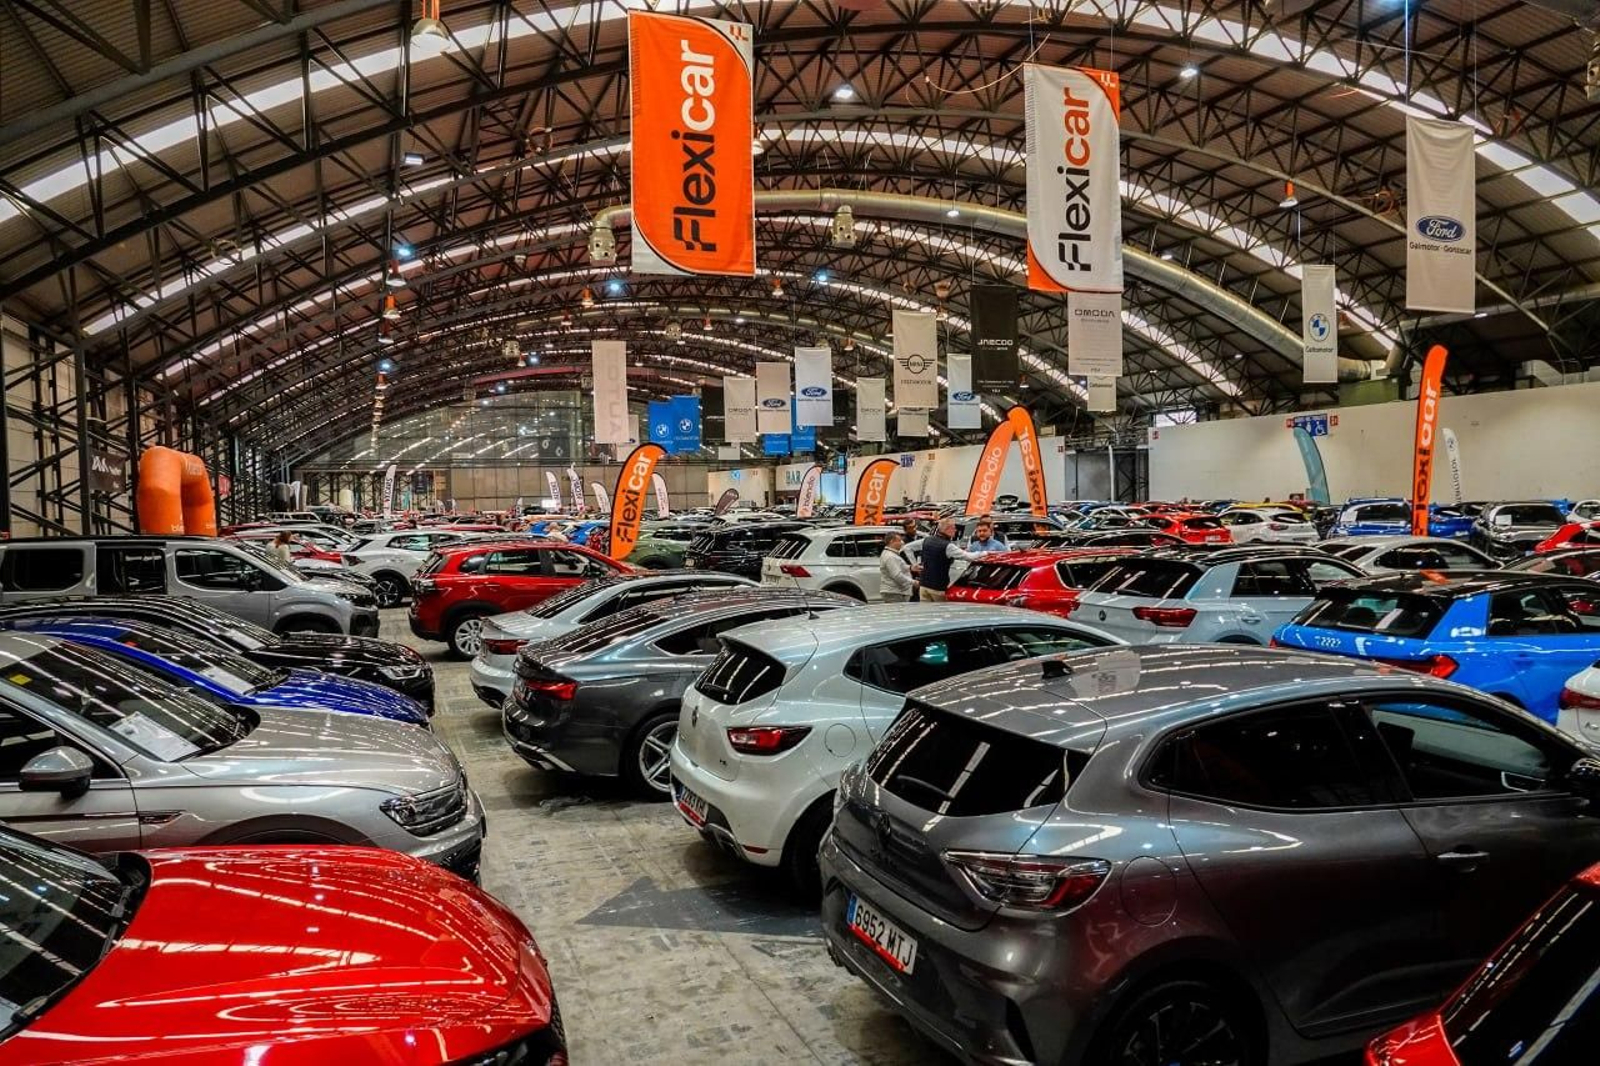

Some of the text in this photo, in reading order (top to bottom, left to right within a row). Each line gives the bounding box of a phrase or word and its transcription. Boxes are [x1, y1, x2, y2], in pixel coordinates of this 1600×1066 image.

[671, 39, 718, 252] Flexicar
[1057, 87, 1092, 272] Flexicar
[1424, 218, 1459, 239] Ford
[616, 452, 652, 544] Flexicar
[854, 904, 912, 967] 6952 MTJ
